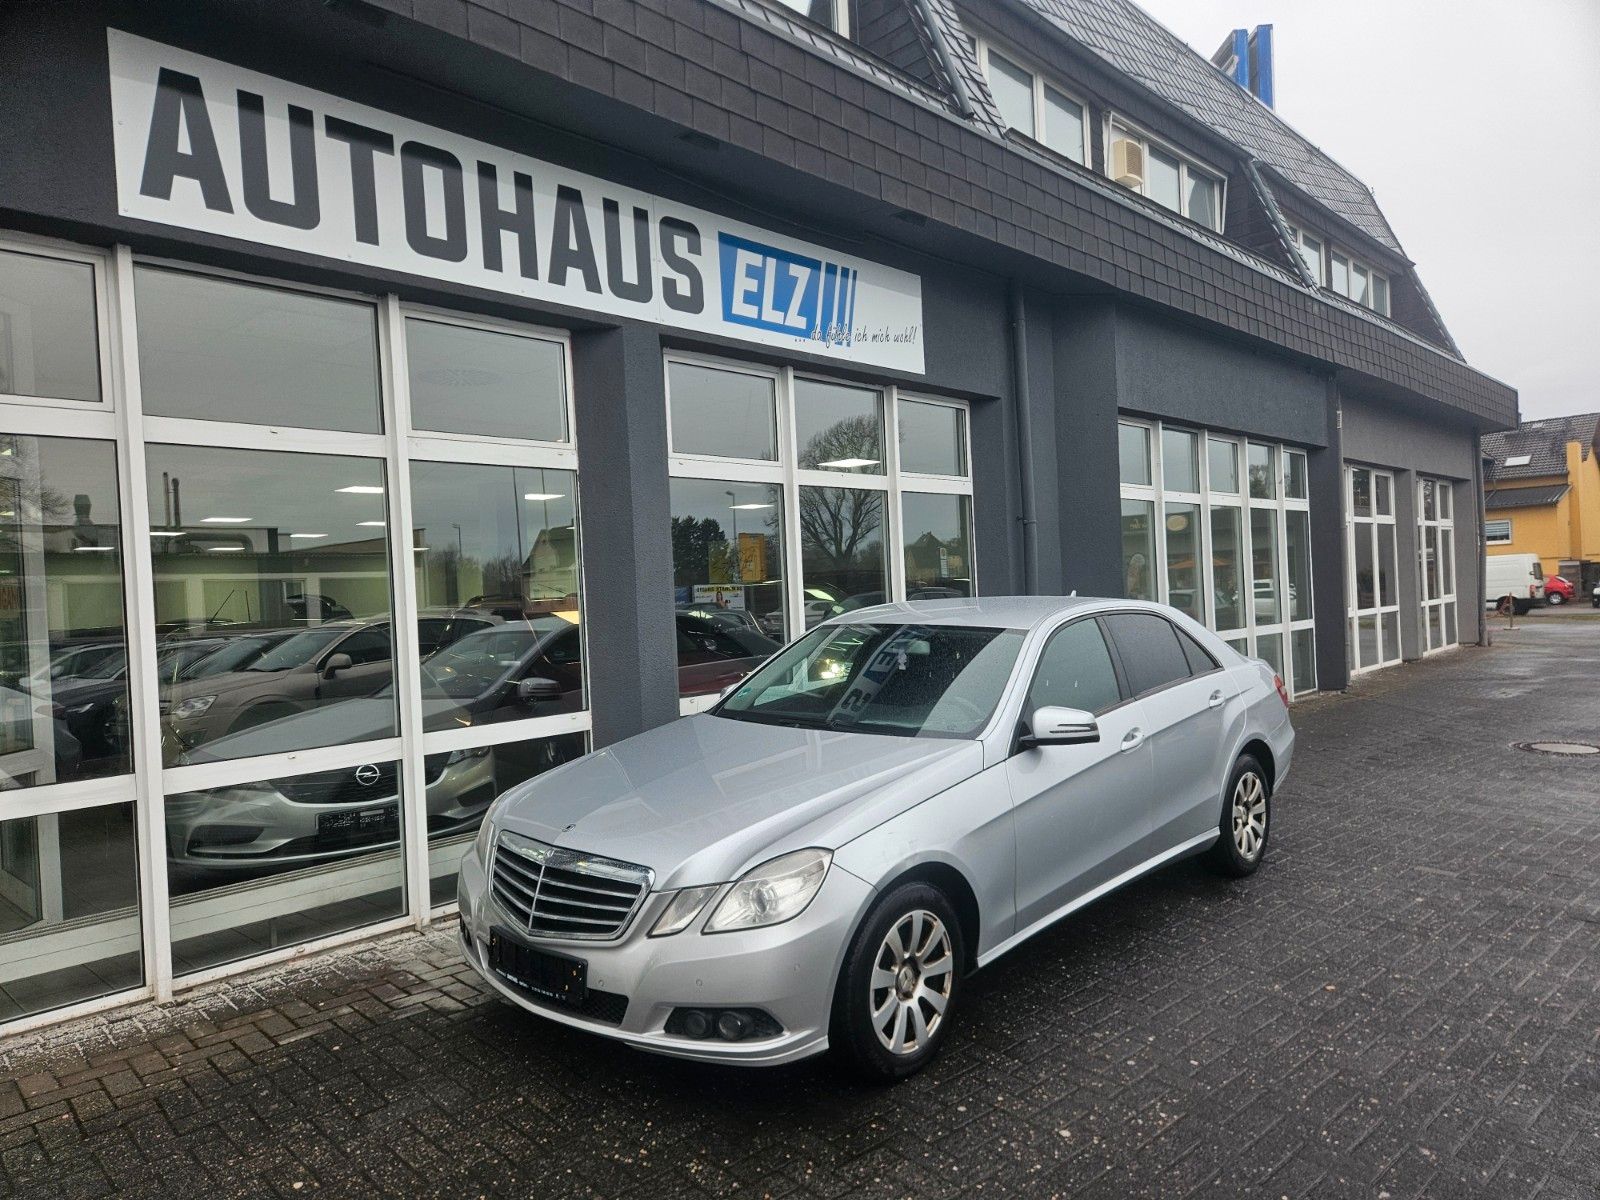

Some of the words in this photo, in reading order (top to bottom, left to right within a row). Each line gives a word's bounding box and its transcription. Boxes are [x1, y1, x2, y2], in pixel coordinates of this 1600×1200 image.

[140, 66, 705, 314] AUTOHAUS
[732, 248, 812, 330] ELZ
[854, 325, 868, 342] ich
[871, 327, 891, 343] mich
[893, 326, 918, 345] wohl!
